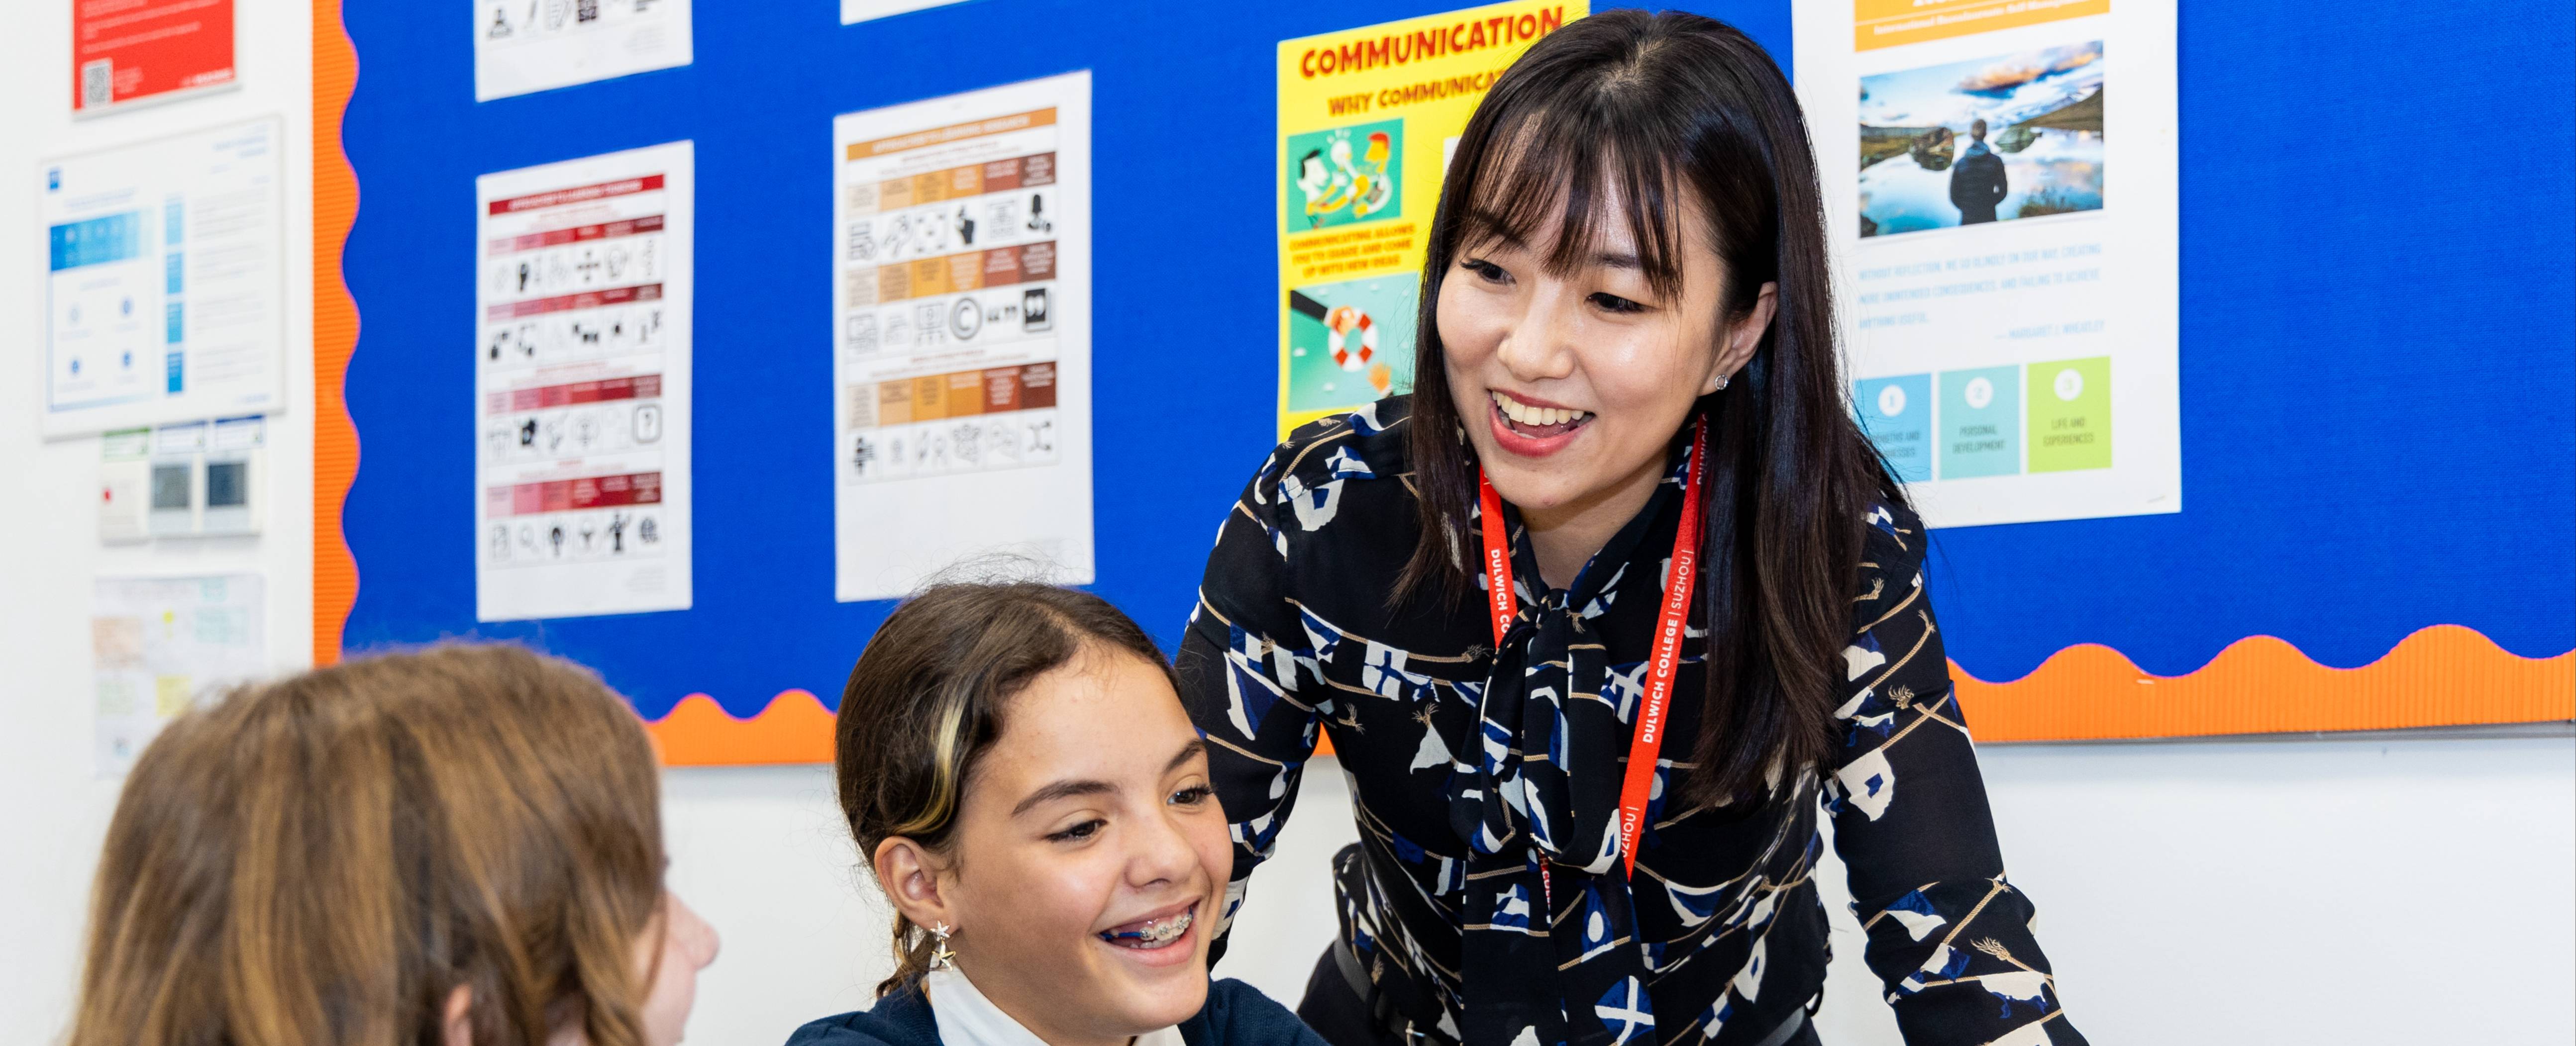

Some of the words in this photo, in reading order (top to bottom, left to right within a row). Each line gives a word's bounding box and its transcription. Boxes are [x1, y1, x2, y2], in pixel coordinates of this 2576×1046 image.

[1301, 6, 1563, 78] COMMUNICATION
[1328, 92, 1372, 116] WHY
[1959, 424, 1996, 438] PERSONAL
[2051, 417, 2068, 430] LIFE
[2069, 416, 2086, 428] AND
[1953, 439, 2006, 454] DEVELOPMENT
[1491, 549, 1508, 611] DULWICH
[1499, 614, 1510, 637] CO
[1643, 681, 1665, 744] DULWICH
[1657, 618, 1678, 678] COLLEGE
[1671, 556, 1691, 609] SUZHOU
[1621, 813, 1637, 858] UZHOU
